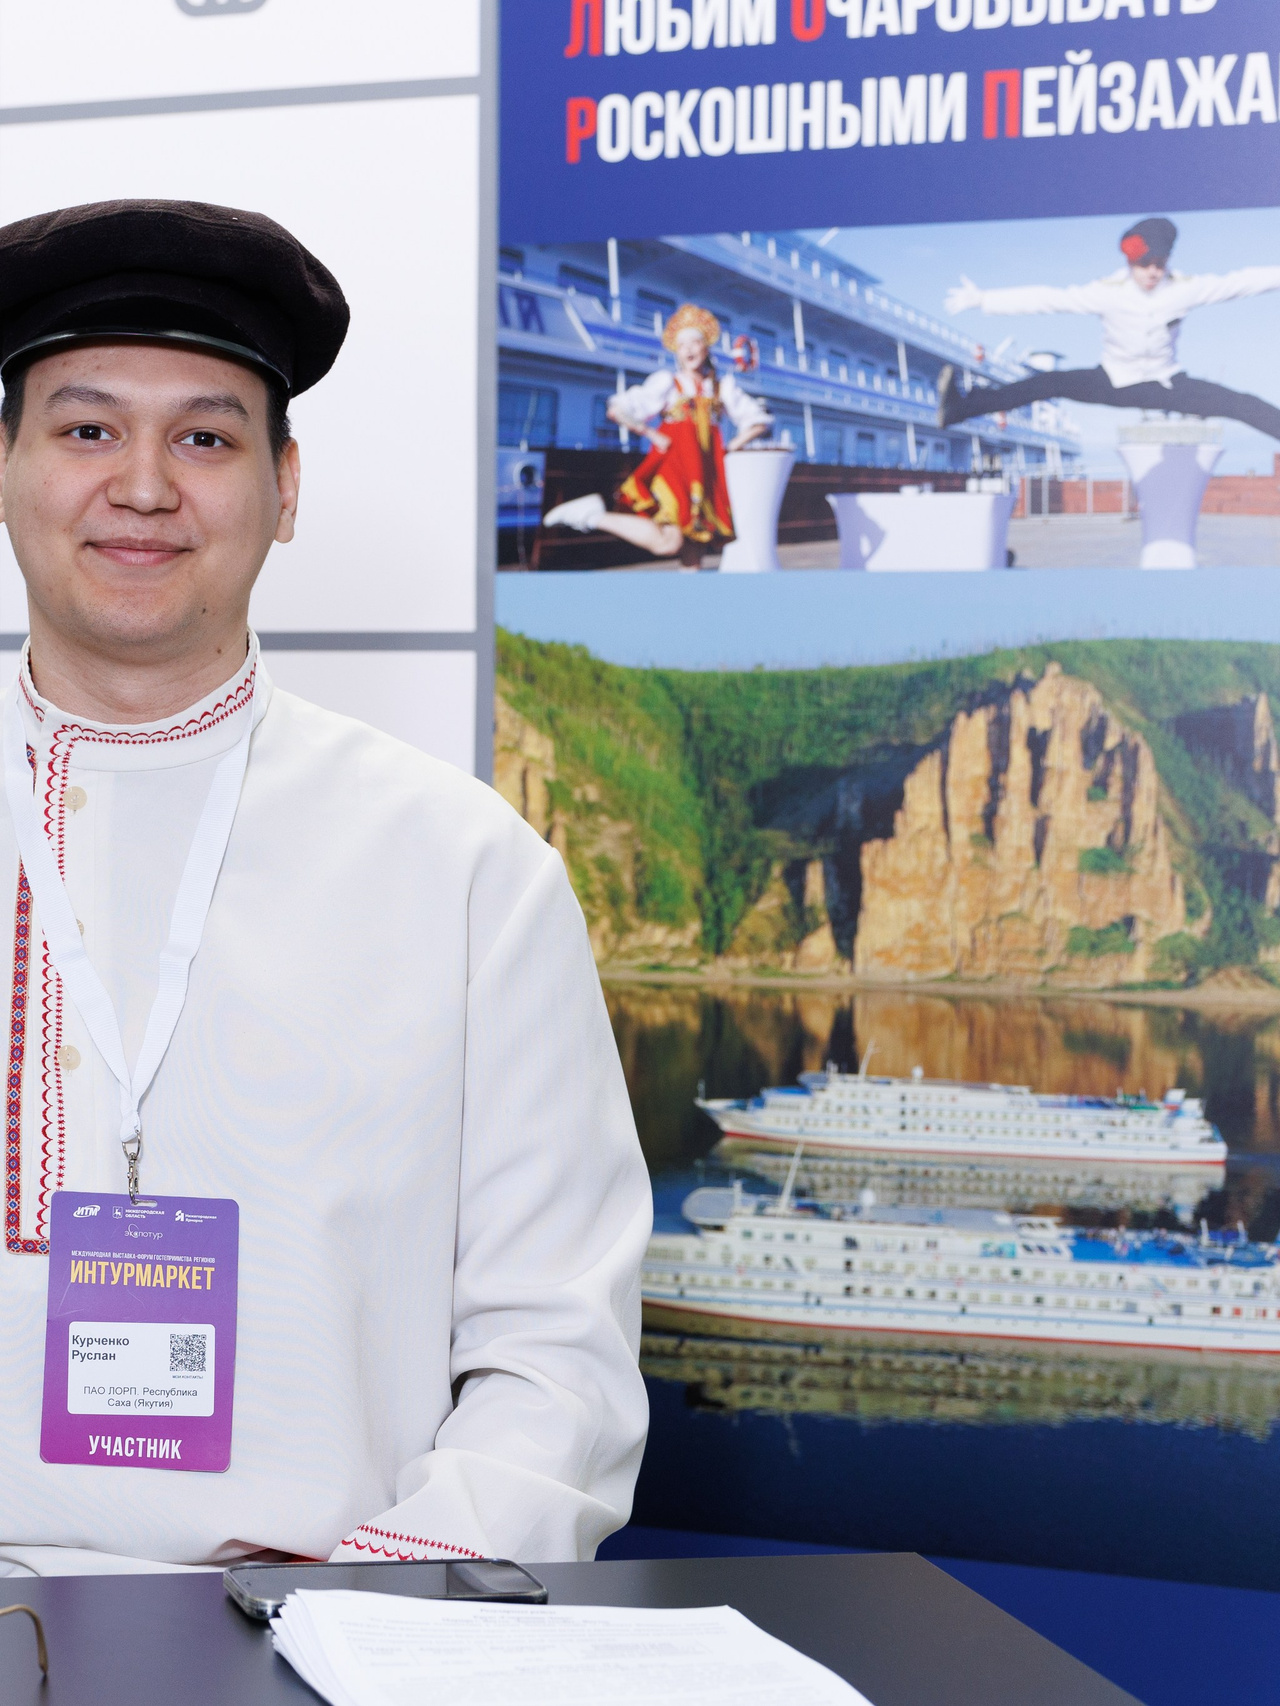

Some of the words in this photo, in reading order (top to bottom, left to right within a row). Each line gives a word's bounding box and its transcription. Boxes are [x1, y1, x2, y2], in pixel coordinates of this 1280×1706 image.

[564, 0, 776, 58] ЛЮБИМ
[565, 71, 968, 165] РОСКОШНЫМИ
[983, 48, 1280, 140] ПЕЙЗАЖА
[70, 1259, 215, 1291] ИНТУРМАРКЕТ
[72, 1334, 130, 1348] Курченко
[71, 1350, 116, 1363] Руслан
[83, 1386, 106, 1395] ПАО
[108, 1386, 140, 1396] ЛОРП.
[142, 1387, 198, 1398] Республика
[107, 1398, 131, 1407] Саха
[133, 1399, 173, 1410] (Якутия)
[88, 1435, 183, 1460] УЧАСТНИК
